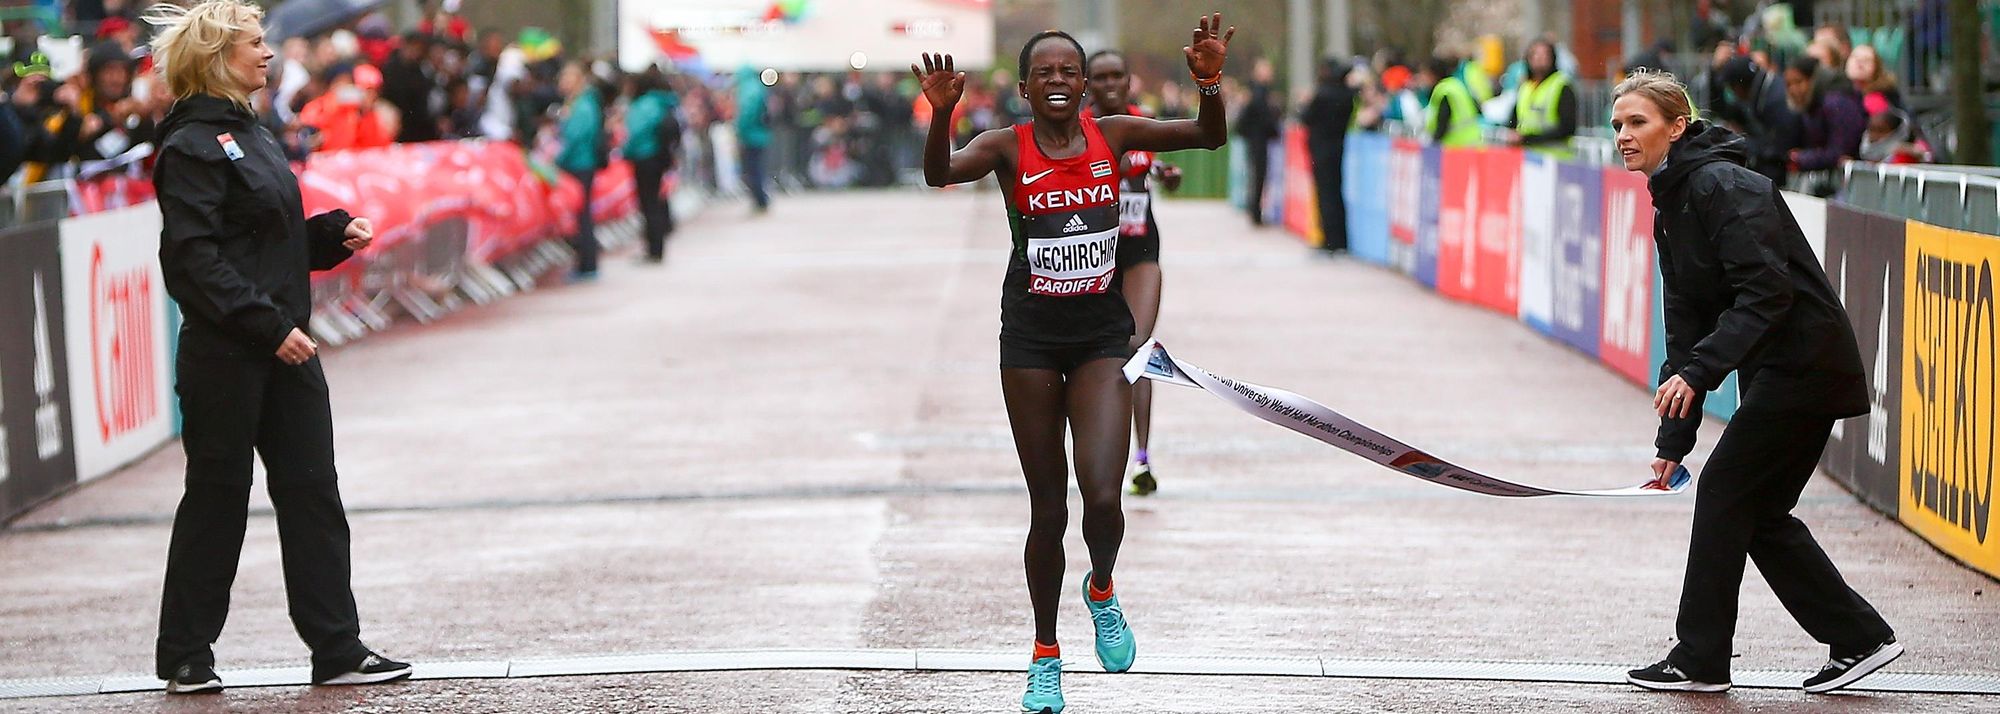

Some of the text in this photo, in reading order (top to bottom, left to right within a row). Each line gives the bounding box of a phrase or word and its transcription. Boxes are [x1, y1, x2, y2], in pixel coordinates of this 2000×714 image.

[1028, 184, 1114, 211] KENYA
[1063, 224, 1088, 233] adidas
[1033, 236, 1116, 272] JECHIRCHIR
[1034, 278, 1096, 294] CARDIFF
[1234, 382, 1271, 408] University
[1269, 399, 1296, 416] World
[1911, 247, 1996, 545] SEIKO
